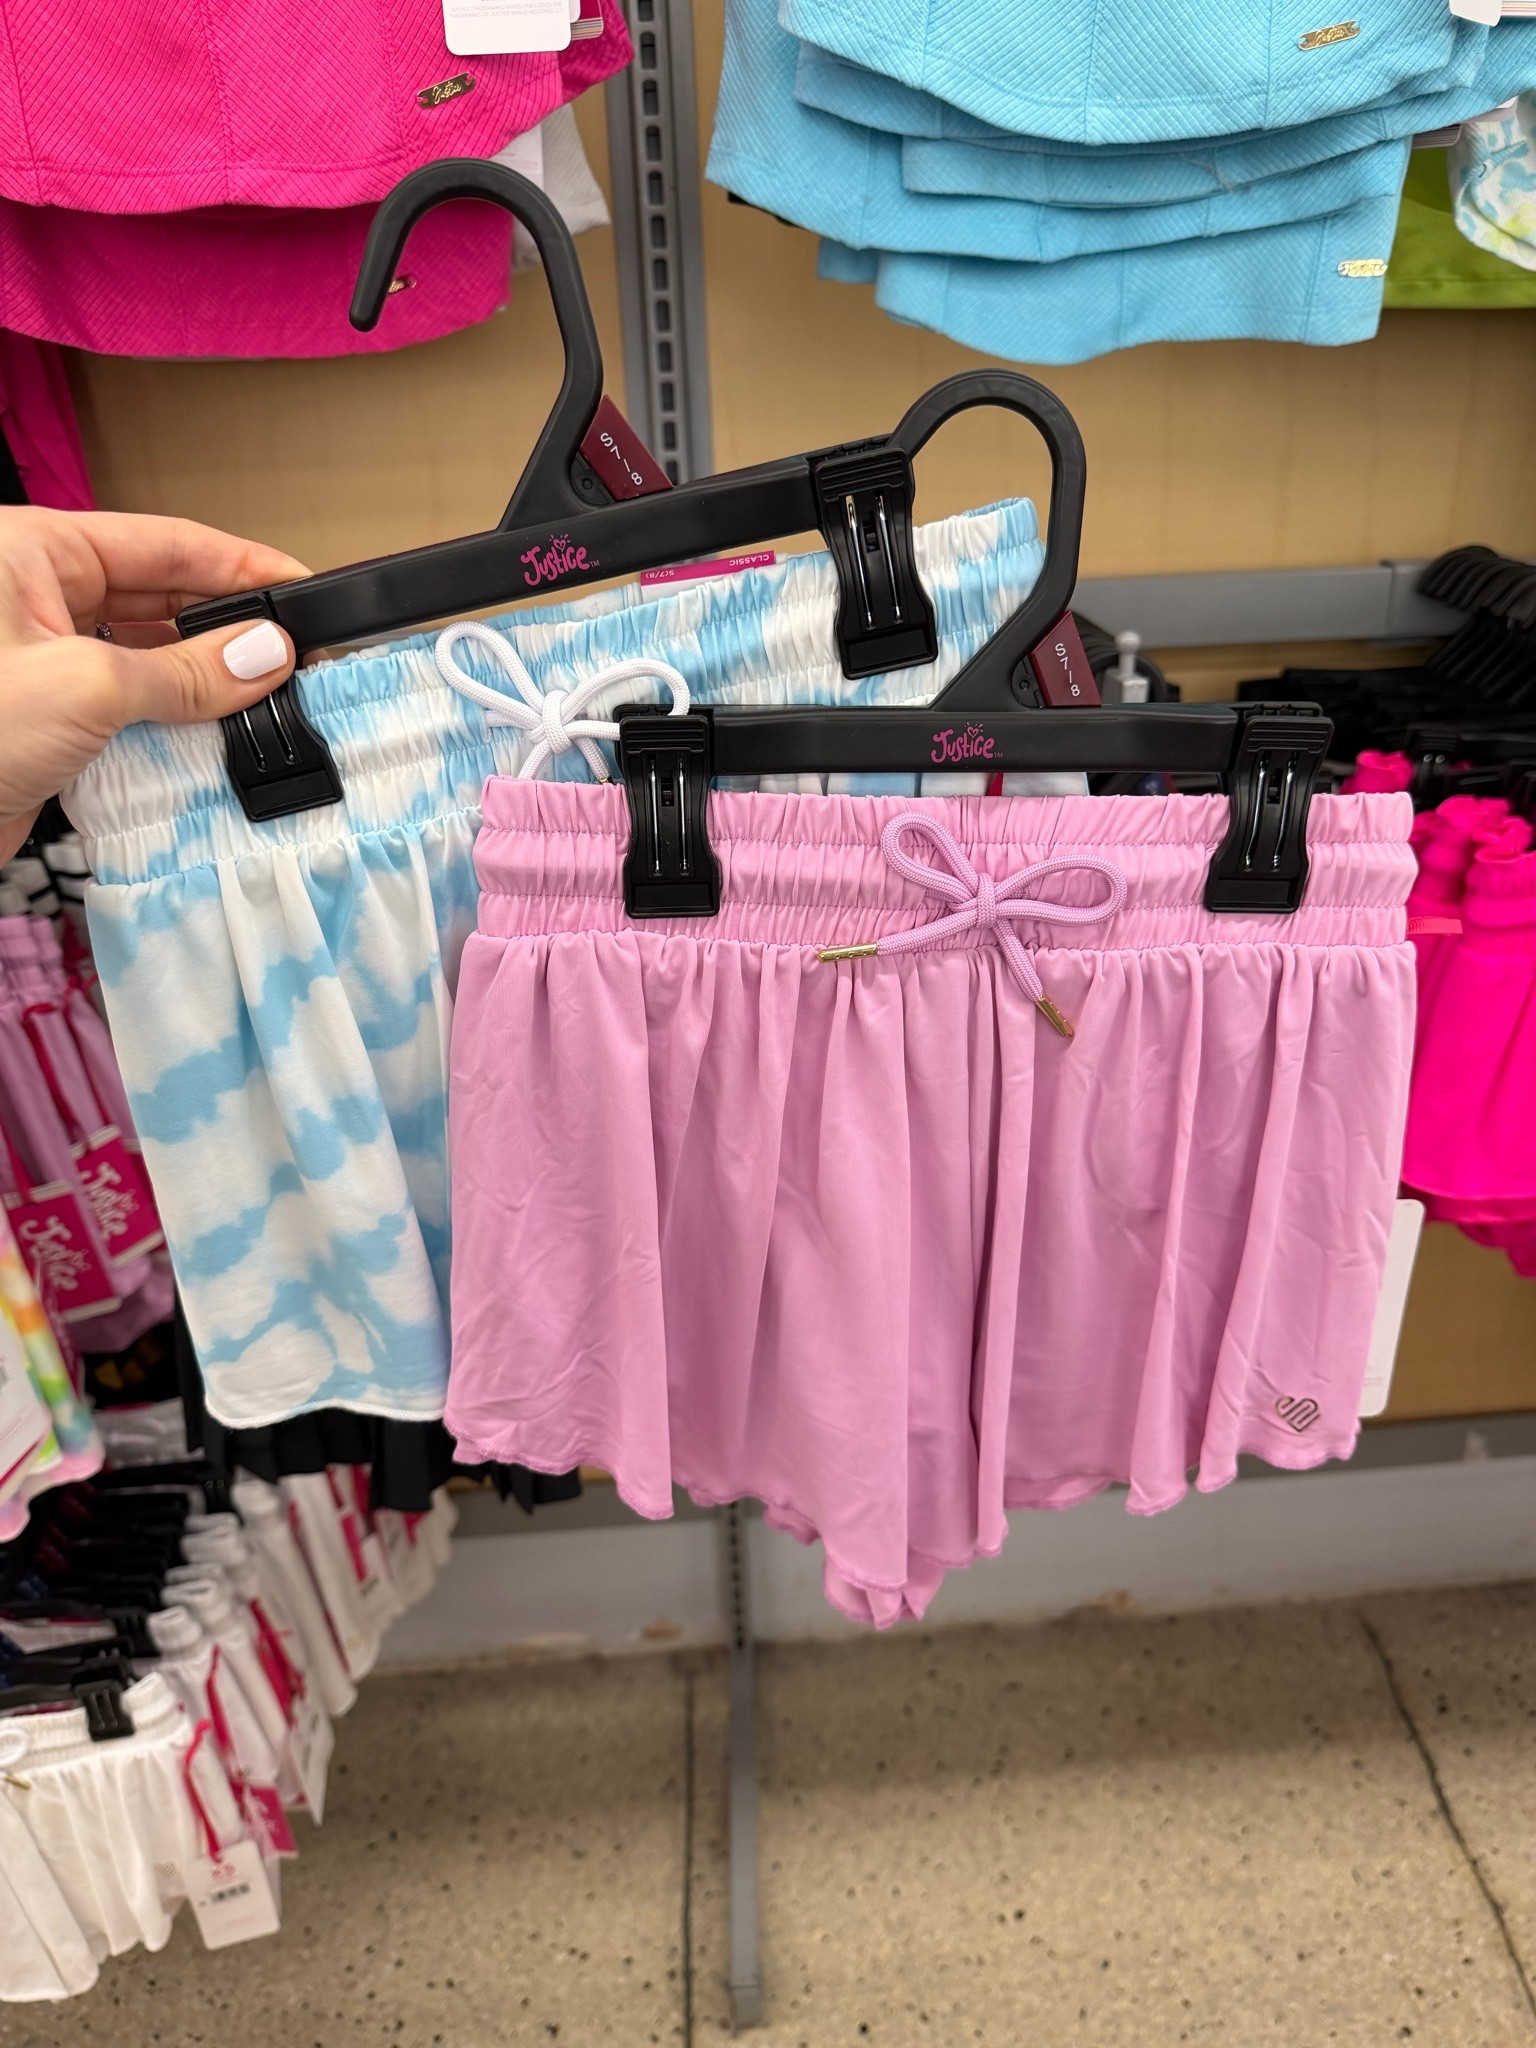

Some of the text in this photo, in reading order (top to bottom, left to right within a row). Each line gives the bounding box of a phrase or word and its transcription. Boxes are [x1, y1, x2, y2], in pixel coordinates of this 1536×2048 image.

[520, 534, 590, 586] Justice
[645, 553, 770, 579] CLASSIC S(7/8)
[931, 722, 995, 763] Justice
